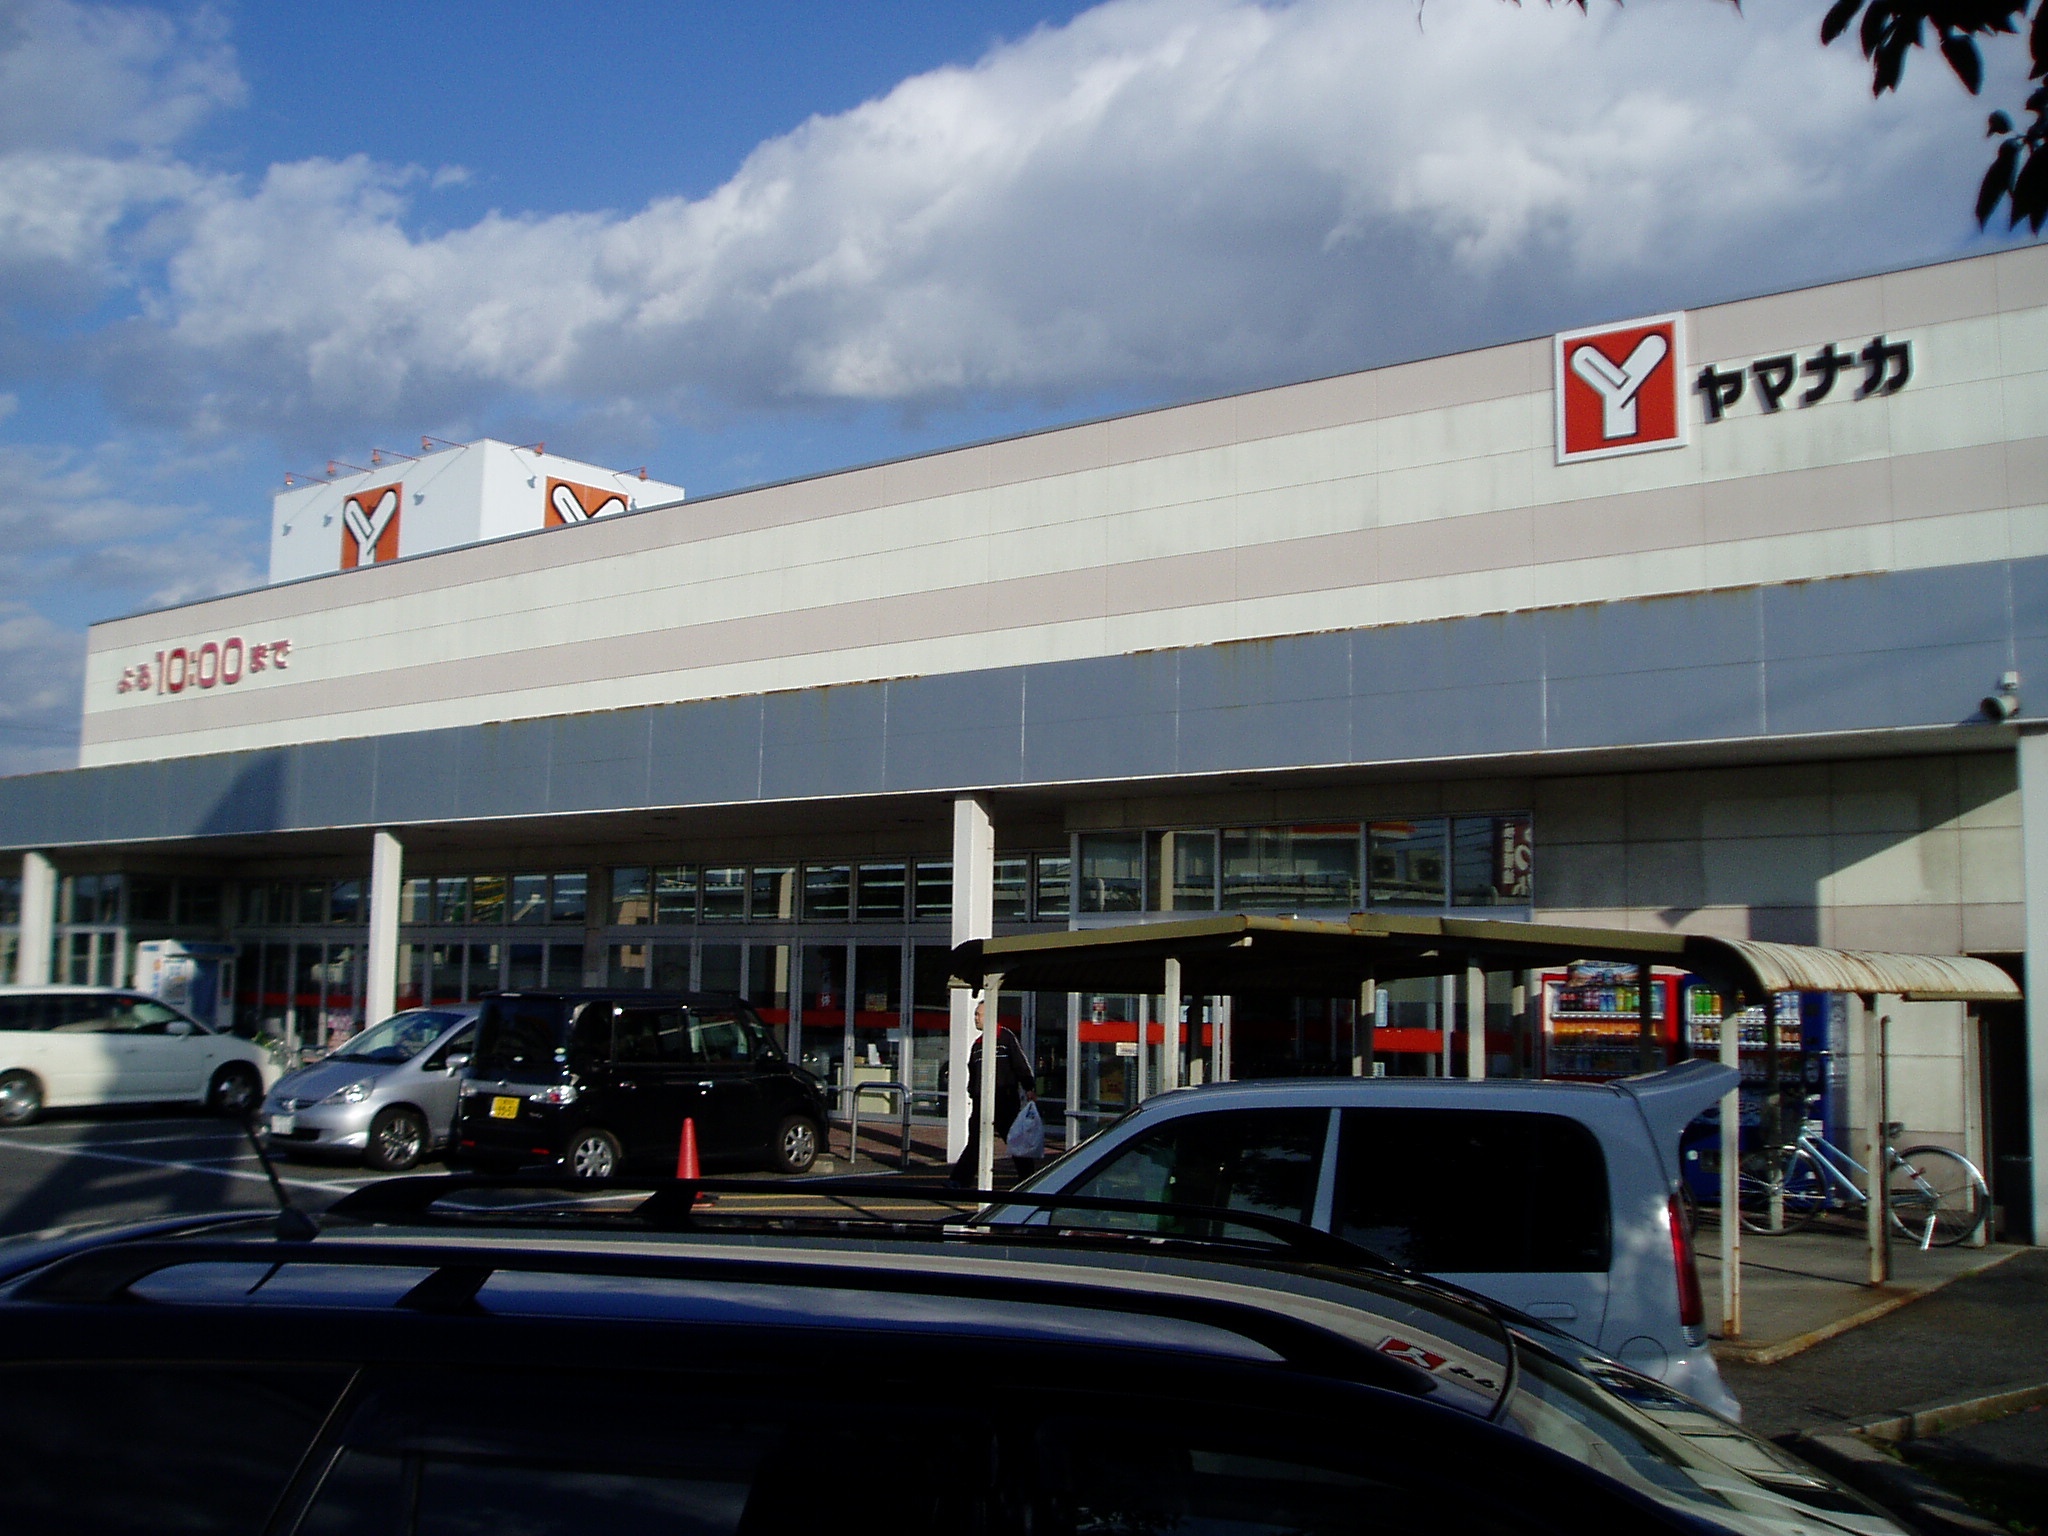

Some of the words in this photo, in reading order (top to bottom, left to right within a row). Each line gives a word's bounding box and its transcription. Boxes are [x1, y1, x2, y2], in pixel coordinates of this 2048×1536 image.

[1570, 333, 1669, 440] Y
[1697, 334, 1915, 421] ヤマナカ
[343, 488, 398, 565] Y
